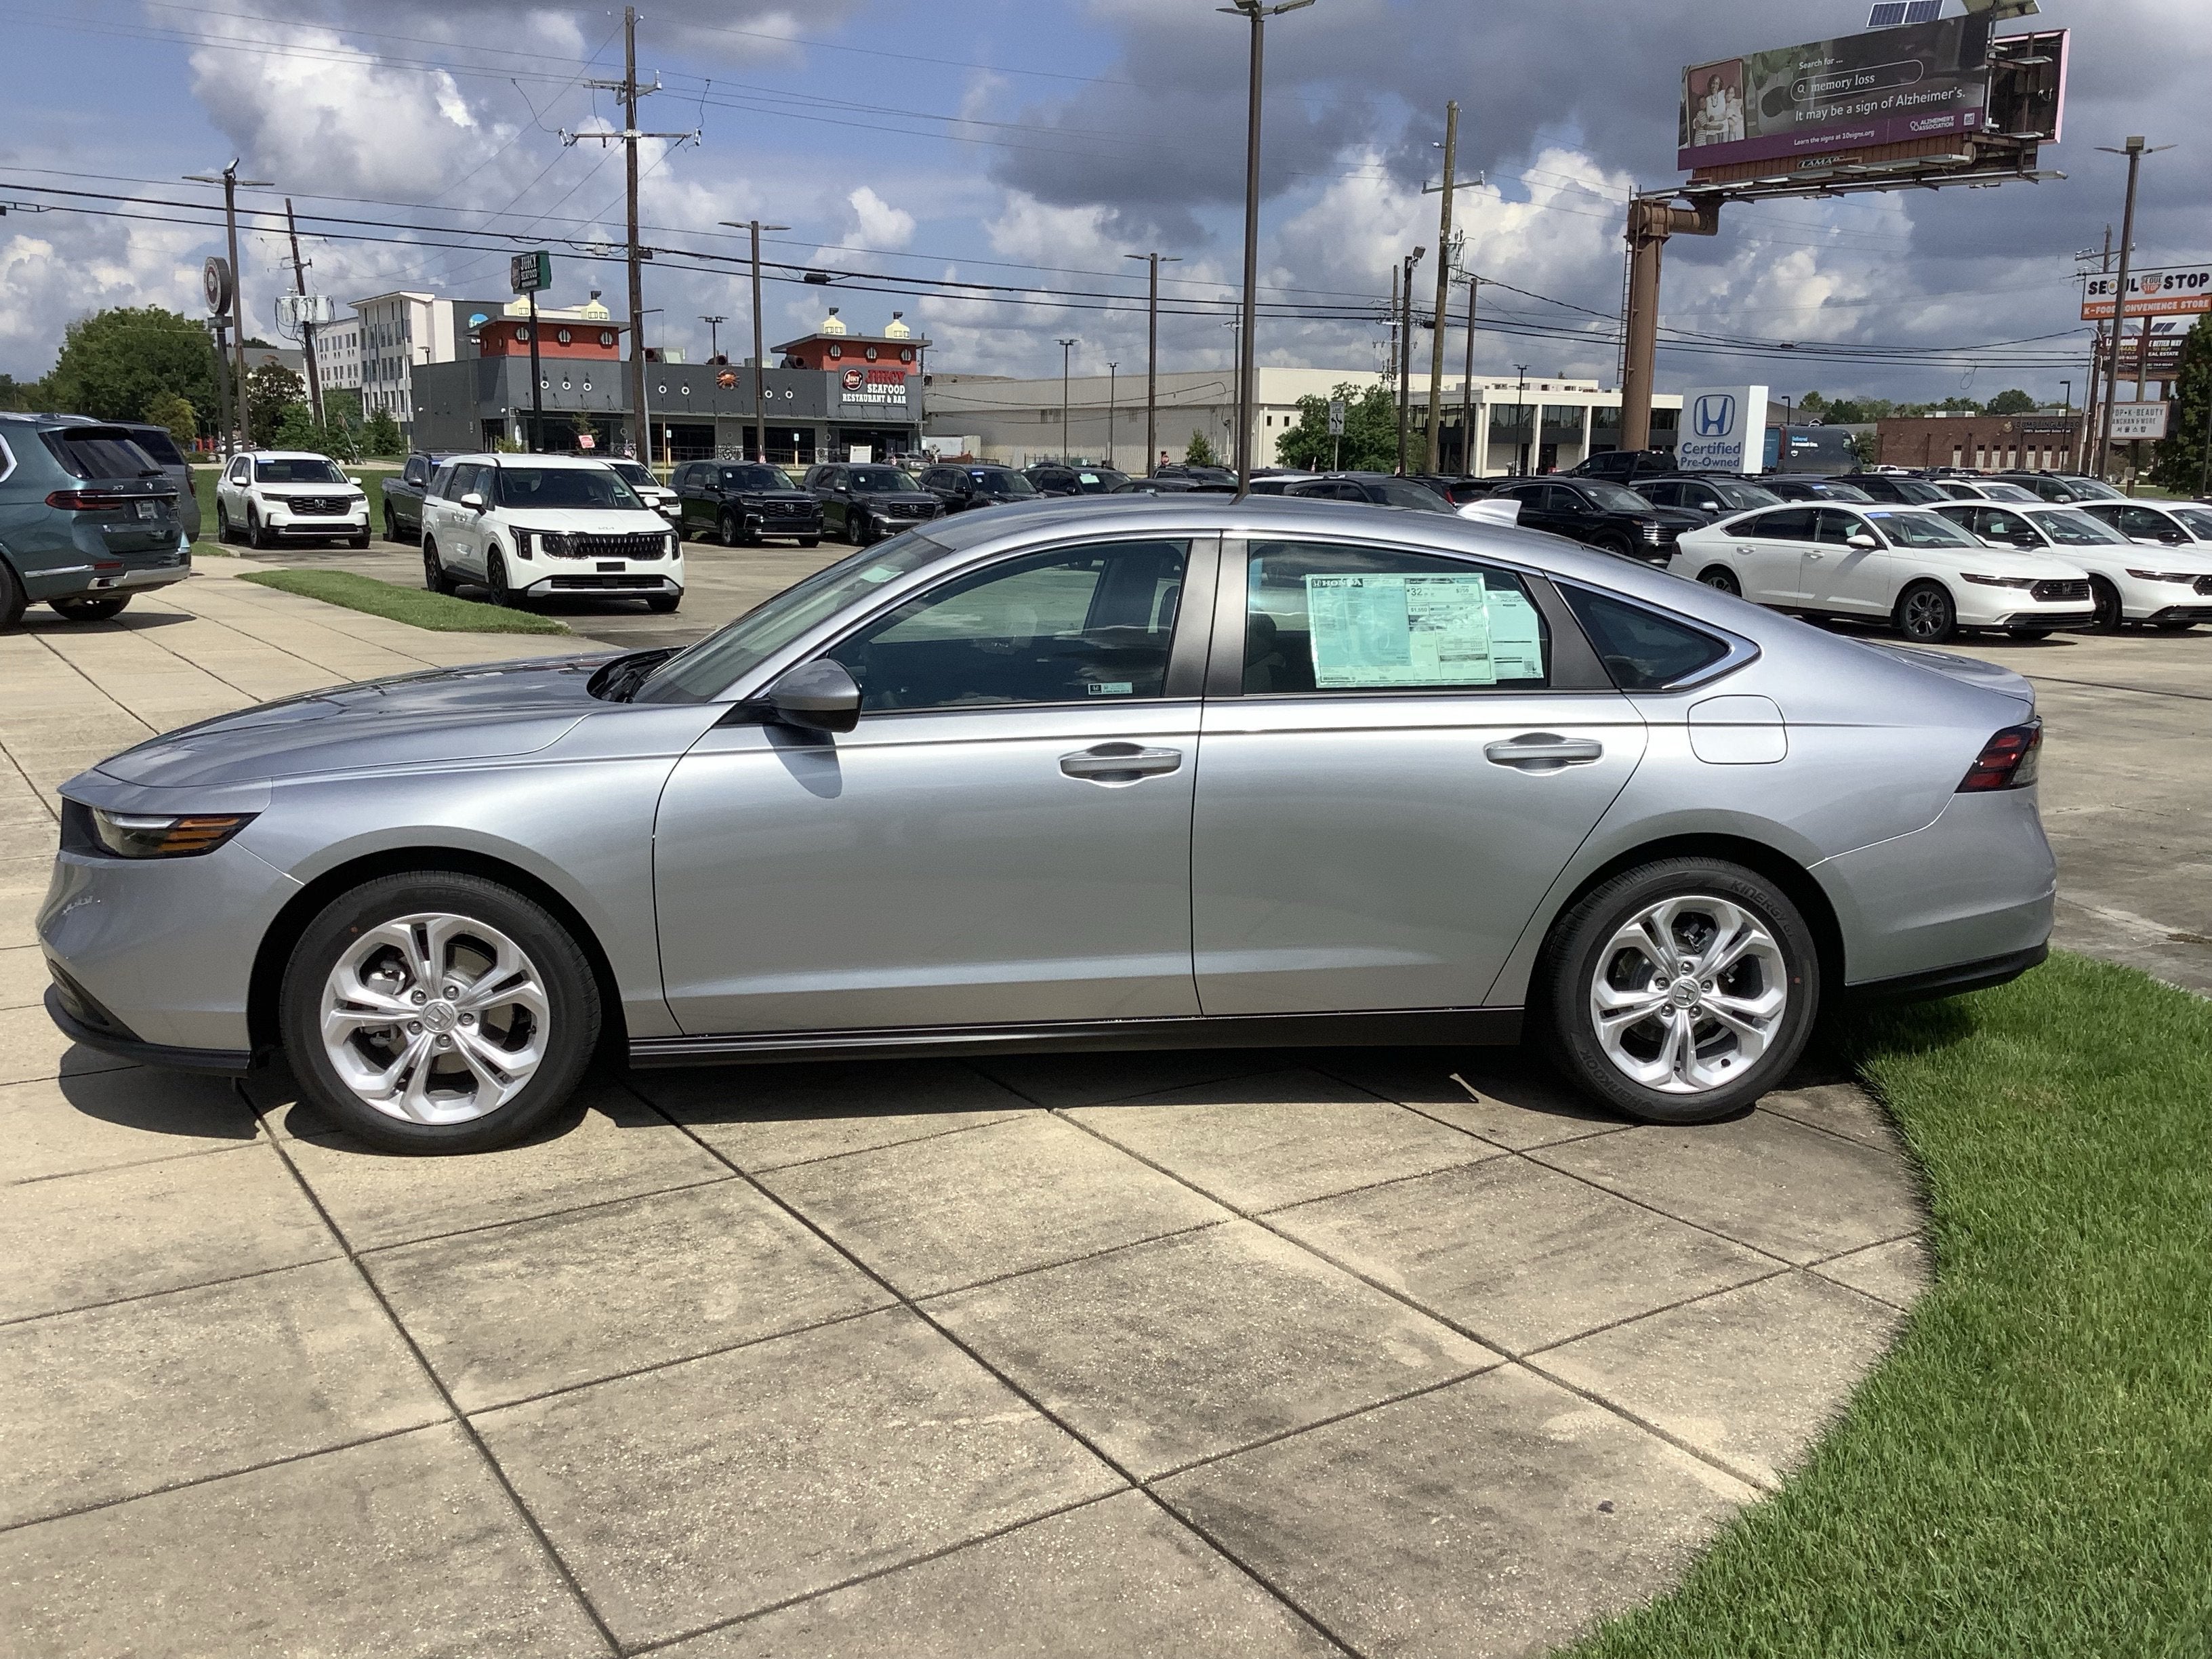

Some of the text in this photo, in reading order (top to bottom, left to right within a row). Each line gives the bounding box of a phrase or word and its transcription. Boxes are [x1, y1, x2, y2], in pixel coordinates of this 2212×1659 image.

[1799, 58, 1822, 69] Search
[1824, 58, 1835, 66] for
[1811, 75, 1875, 92] memory loss
[1796, 110, 1803, 121] It
[1806, 108, 1828, 121] may
[1830, 105, 1843, 117] be
[1847, 106, 1852, 114] a
[1856, 101, 1878, 115] sign
[1881, 96, 1893, 109] of
[1919, 121, 1954, 131] ASSOCIATION
[1820, 135, 1835, 143] signs
[2163, 272, 2210, 290] STOP
[2125, 302, 2177, 313] ONVENIENCE
[2180, 300, 2210, 310] STORE
[867, 384, 905, 394] SEAFOOD
[842, 393, 907, 404] RESTAURANT & BAR
[1681, 442, 1742, 455] Certified
[1681, 456, 1740, 468] Pre-Owned
[1410, 588, 1423, 596] 32
